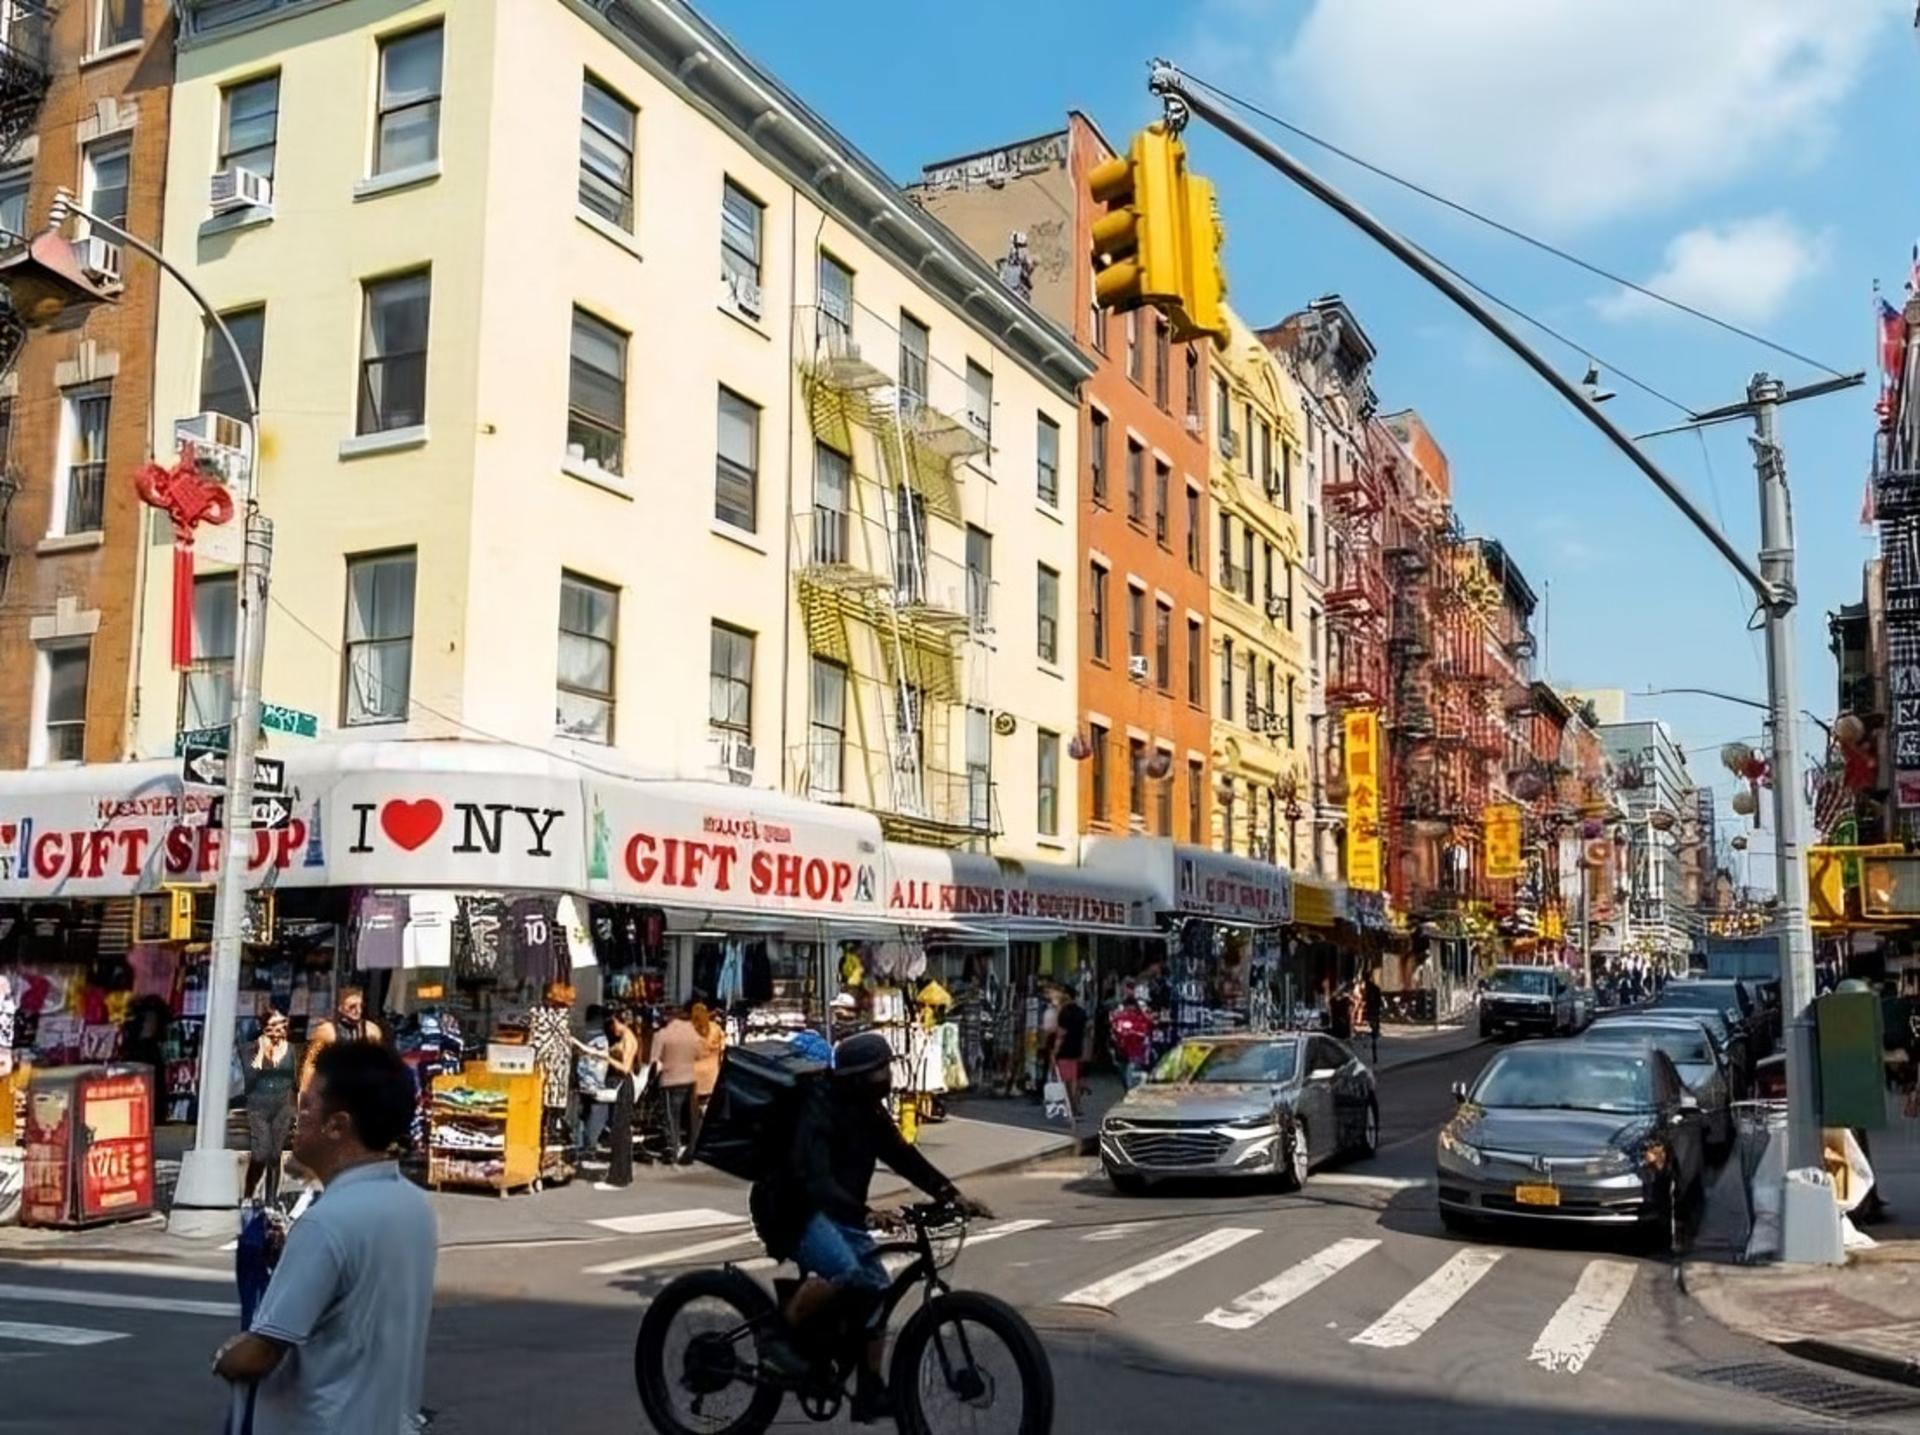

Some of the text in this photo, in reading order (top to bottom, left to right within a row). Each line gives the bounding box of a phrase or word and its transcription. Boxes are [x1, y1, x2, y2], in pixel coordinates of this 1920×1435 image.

[34, 828, 148, 879] GIFT
[350, 803, 565, 856] I NY
[625, 832, 853, 902] GIFT SHOP
[889, 879, 933, 911] ALL
[526, 921, 547, 946] 10
